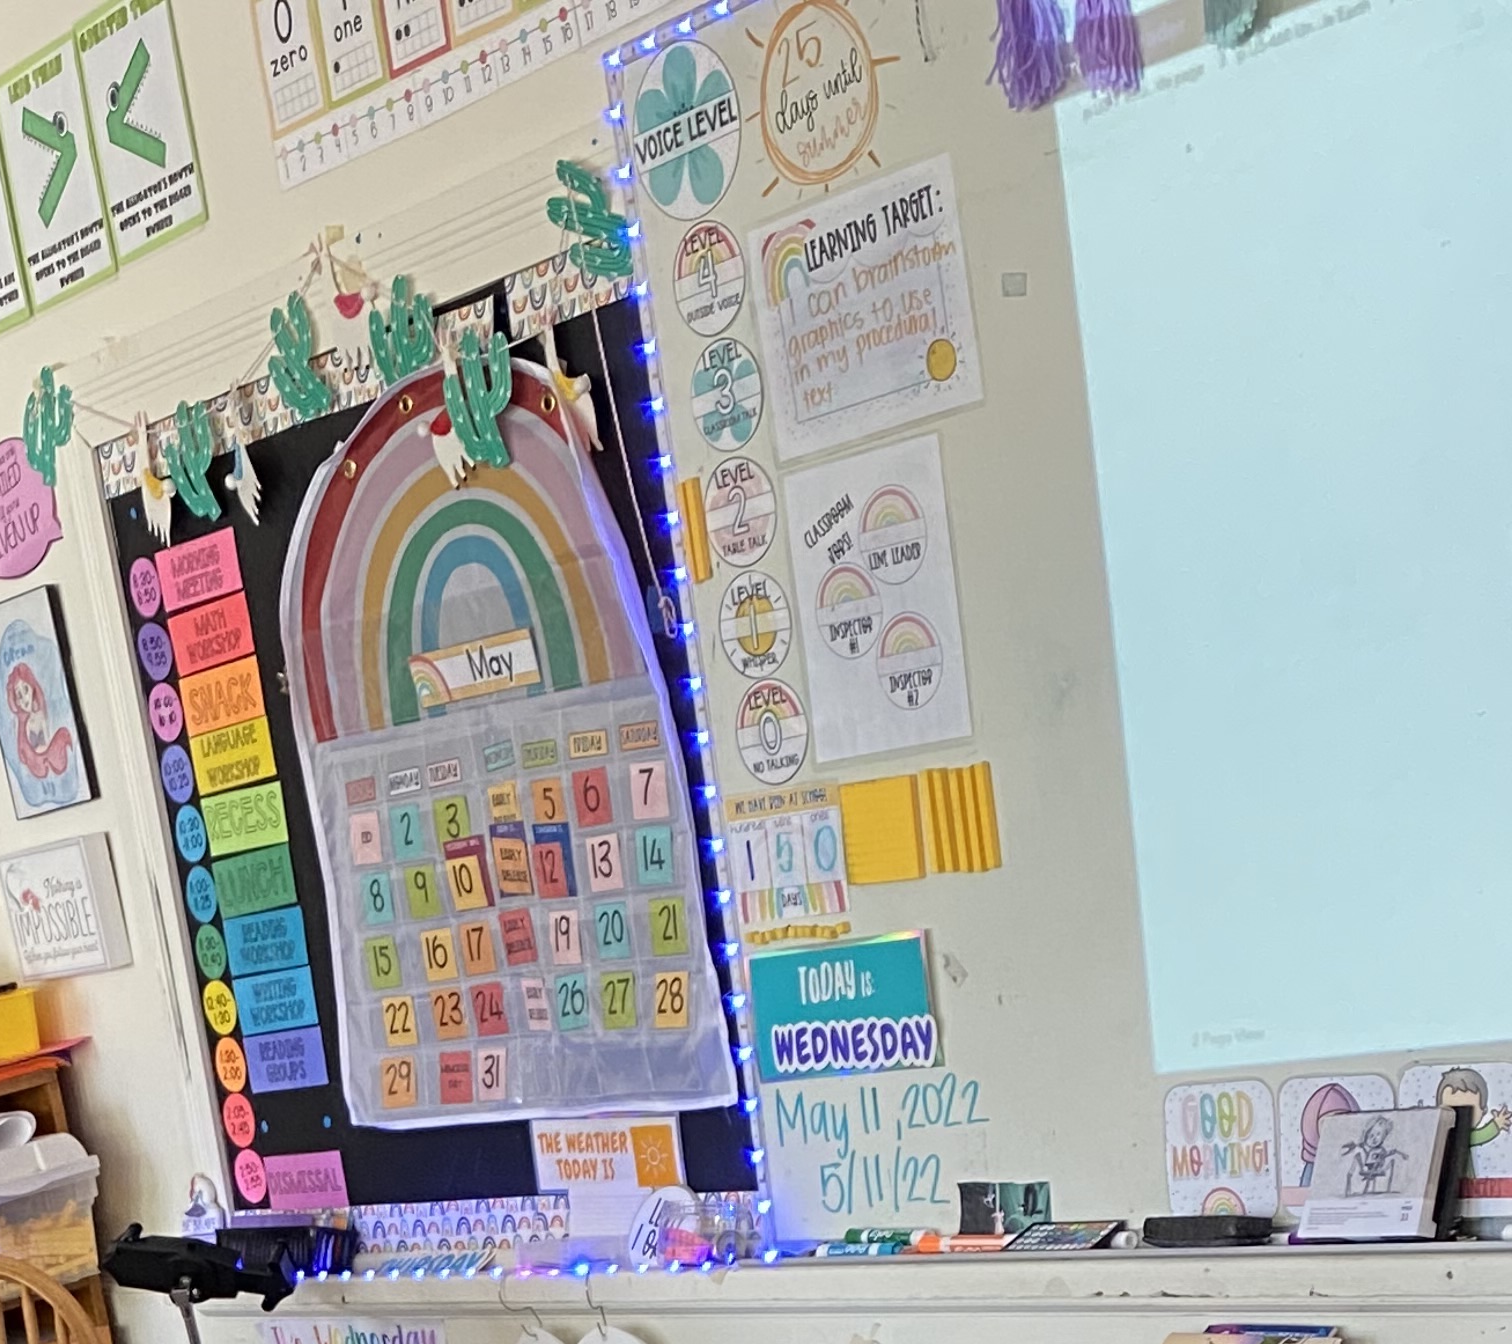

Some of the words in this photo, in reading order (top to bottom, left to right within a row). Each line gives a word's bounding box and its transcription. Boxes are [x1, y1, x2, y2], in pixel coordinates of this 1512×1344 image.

[334, 15, 363, 42] one
[271, 45, 307, 77] zero
[778, 20, 822, 88] 25
[776, 90, 817, 134] days
[824, 47, 863, 98] until
[636, 121, 684, 164] VOICE
[688, 97, 737, 141] LEVEL
[797, 98, 865, 167] summer
[684, 227, 723, 256] LEVEL
[805, 214, 876, 272] LEARNING
[882, 185, 943, 237] TARGET:
[698, 250, 718, 298] 4
[790, 299, 796, 325] I
[808, 281, 847, 317] can
[852, 241, 956, 294] brainstorm
[789, 311, 864, 364] graphics
[872, 297, 893, 322] to
[901, 288, 932, 314] use
[702, 340, 742, 372] LEVEL
[793, 368, 810, 385] in
[817, 346, 849, 373] my
[856, 308, 937, 365] procedural
[713, 369, 735, 415] 3
[803, 382, 833, 410] text
[715, 462, 754, 490] LEVEL
[23, 503, 40, 535] UP
[728, 486, 750, 536] 2
[804, 493, 854, 549] CLASSROOM
[723, 537, 746, 556] TABLE
[747, 533, 767, 551] TALK
[868, 551, 889, 571] LINE
[731, 579, 769, 606] LEVEL
[466, 649, 514, 681] May
[190, 672, 257, 725] SNACK
[747, 689, 787, 711] LEVEL
[200, 723, 257, 758] LANGUAGE
[759, 711, 782, 754] 0
[753, 759, 765, 774] NO
[766, 754, 799, 770] TALKING
[543, 788, 556, 819] 5
[585, 778, 601, 812] 6
[638, 768, 654, 805] 7
[204, 791, 281, 841] RECESS
[399, 812, 414, 846] 2
[446, 803, 460, 838] 3
[540, 850, 558, 884] 12
[591, 845, 614, 879] 13
[642, 836, 665, 871] 14
[219, 856, 287, 907] LUNCH
[370, 878, 385, 913] 8
[415, 871, 427, 905] 9
[453, 863, 473, 897] 10
[782, 892, 802, 908] DAYS
[15, 896, 95, 946] IMPOSSIBLE
[555, 916, 570, 952] 19
[600, 908, 624, 945] 20
[658, 905, 677, 940] 21
[374, 944, 391, 976] 15
[426, 935, 448, 969] 16
[467, 927, 483, 961] 17
[558, 980, 584, 1017] 26
[604, 979, 631, 1016] 27
[656, 978, 684, 1014] 28
[798, 959, 855, 1005] TODAY
[385, 1002, 412, 1036] 22
[434, 992, 463, 1026] 23
[476, 991, 503, 1023] 24
[774, 1020, 933, 1067] WEDNESDAY
[385, 1061, 412, 1096] 29
[482, 1055, 500, 1089] 31
[776, 1088, 848, 1158] May
[1181, 1091, 1254, 1143] GOOD
[538, 1132, 563, 1154] THE
[566, 1131, 629, 1154] WEATHER
[556, 1158, 599, 1180] TODAY
[603, 1157, 615, 1180] IS
[1171, 1143, 1270, 1180] MORNING!
[820, 1146, 950, 1214] 5/11/22
